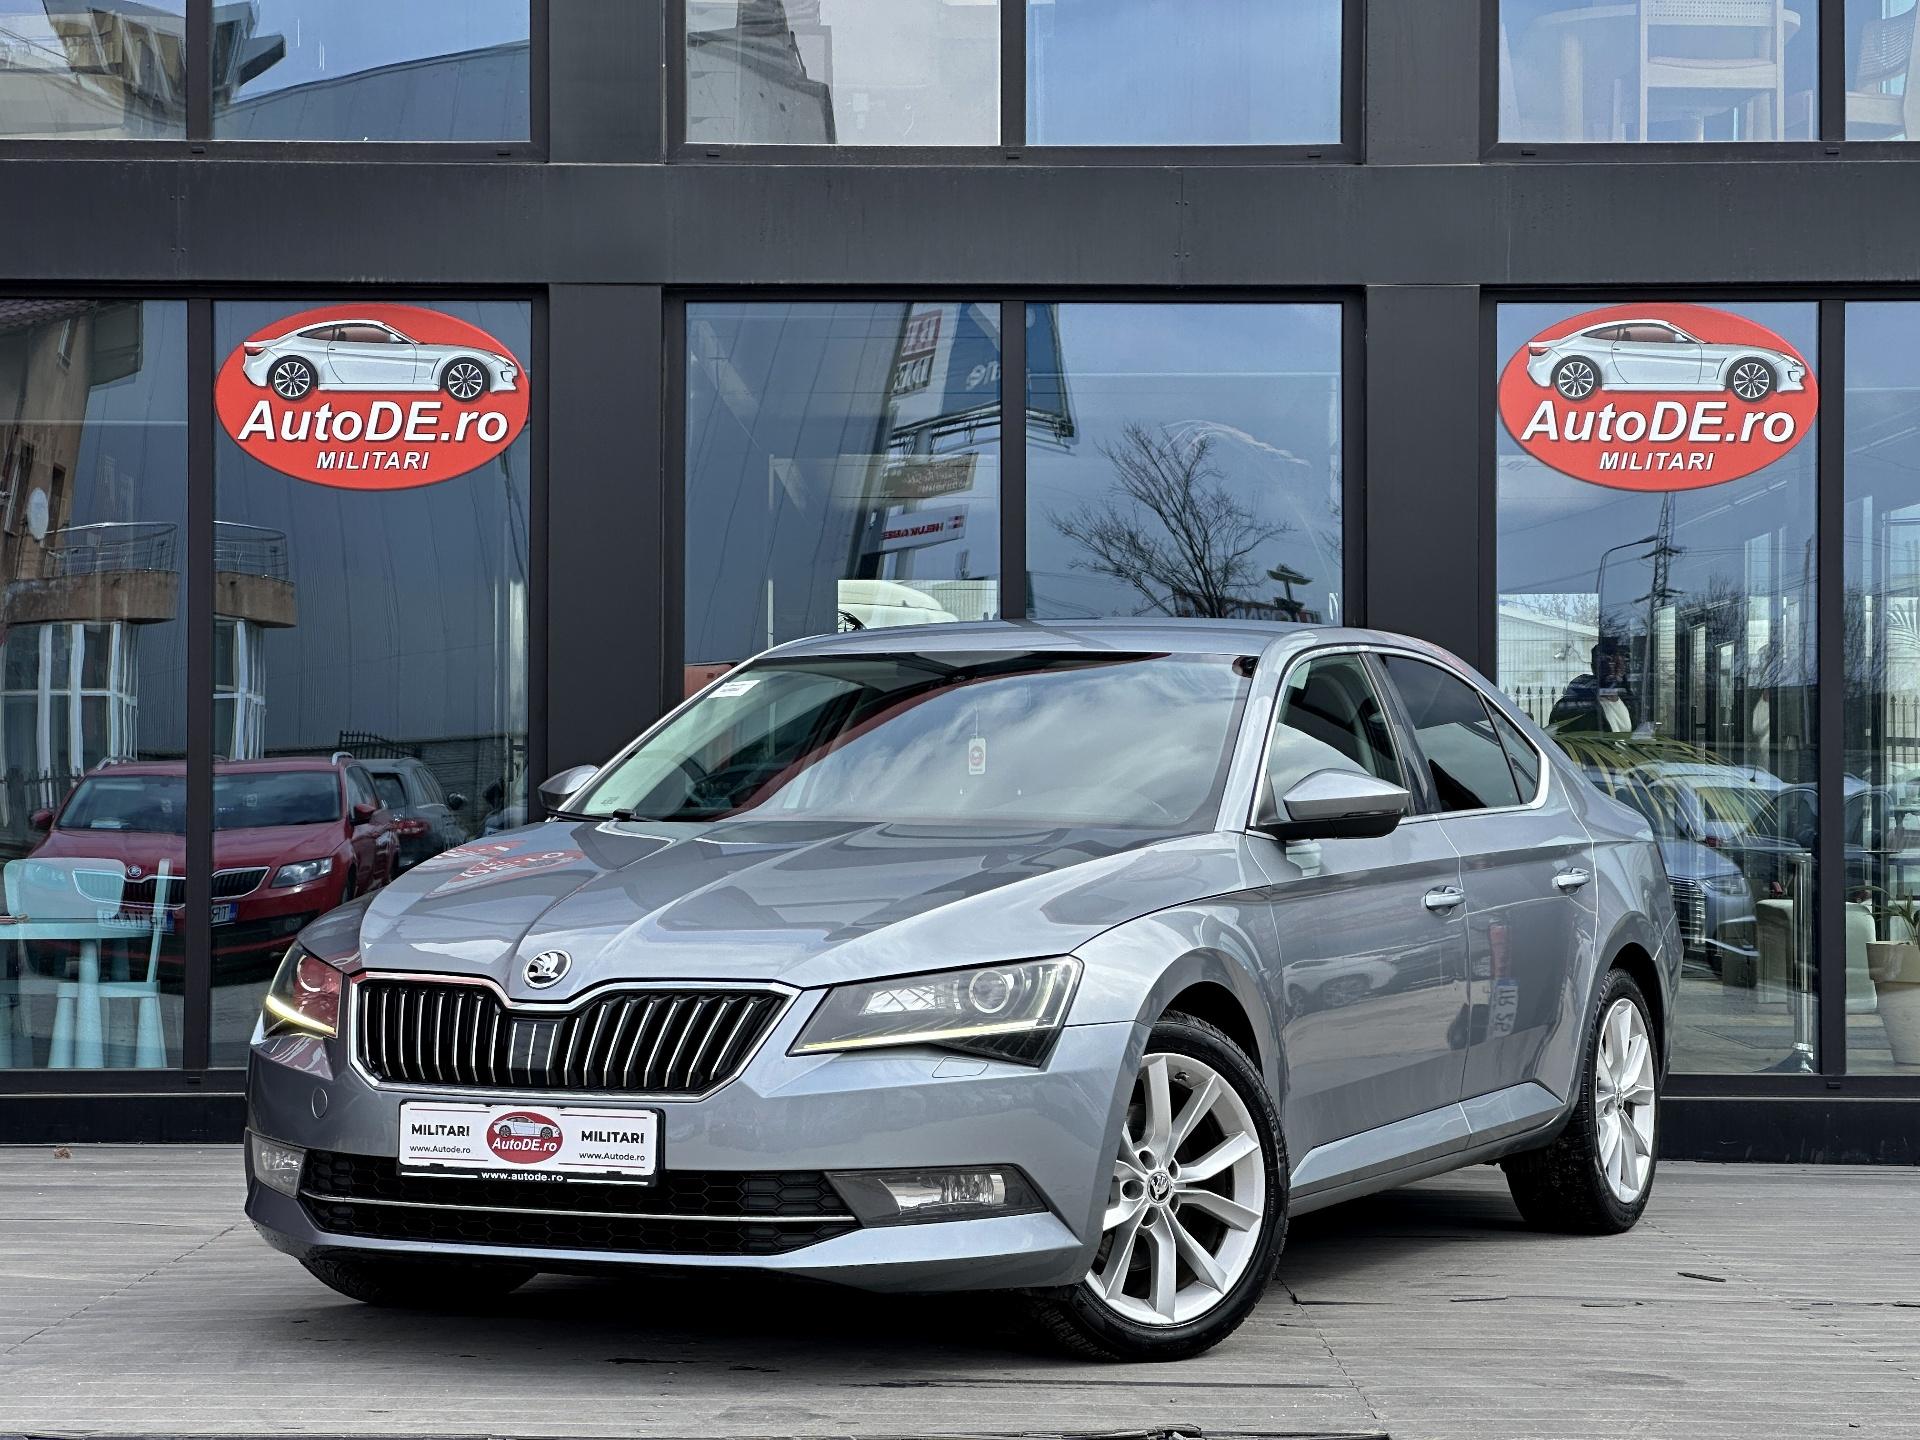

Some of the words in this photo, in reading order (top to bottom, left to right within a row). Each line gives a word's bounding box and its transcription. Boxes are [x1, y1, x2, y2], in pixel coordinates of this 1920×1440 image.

[237, 400, 509, 442] AutoDE.ro
[1520, 400, 1795, 443] AutoDE.ro
[316, 451, 430, 470] MILITARI
[1599, 452, 1715, 471] MILITARI
[411, 1123, 470, 1137] MILITARI
[581, 1130, 645, 1144] MILITARI
[409, 1144, 471, 1154] www.Autode.ro
[491, 1137, 557, 1152] AutoDE.ro
[578, 1151, 646, 1162] www.Autode.ro
[481, 1170, 563, 1182] www.autode.ro
